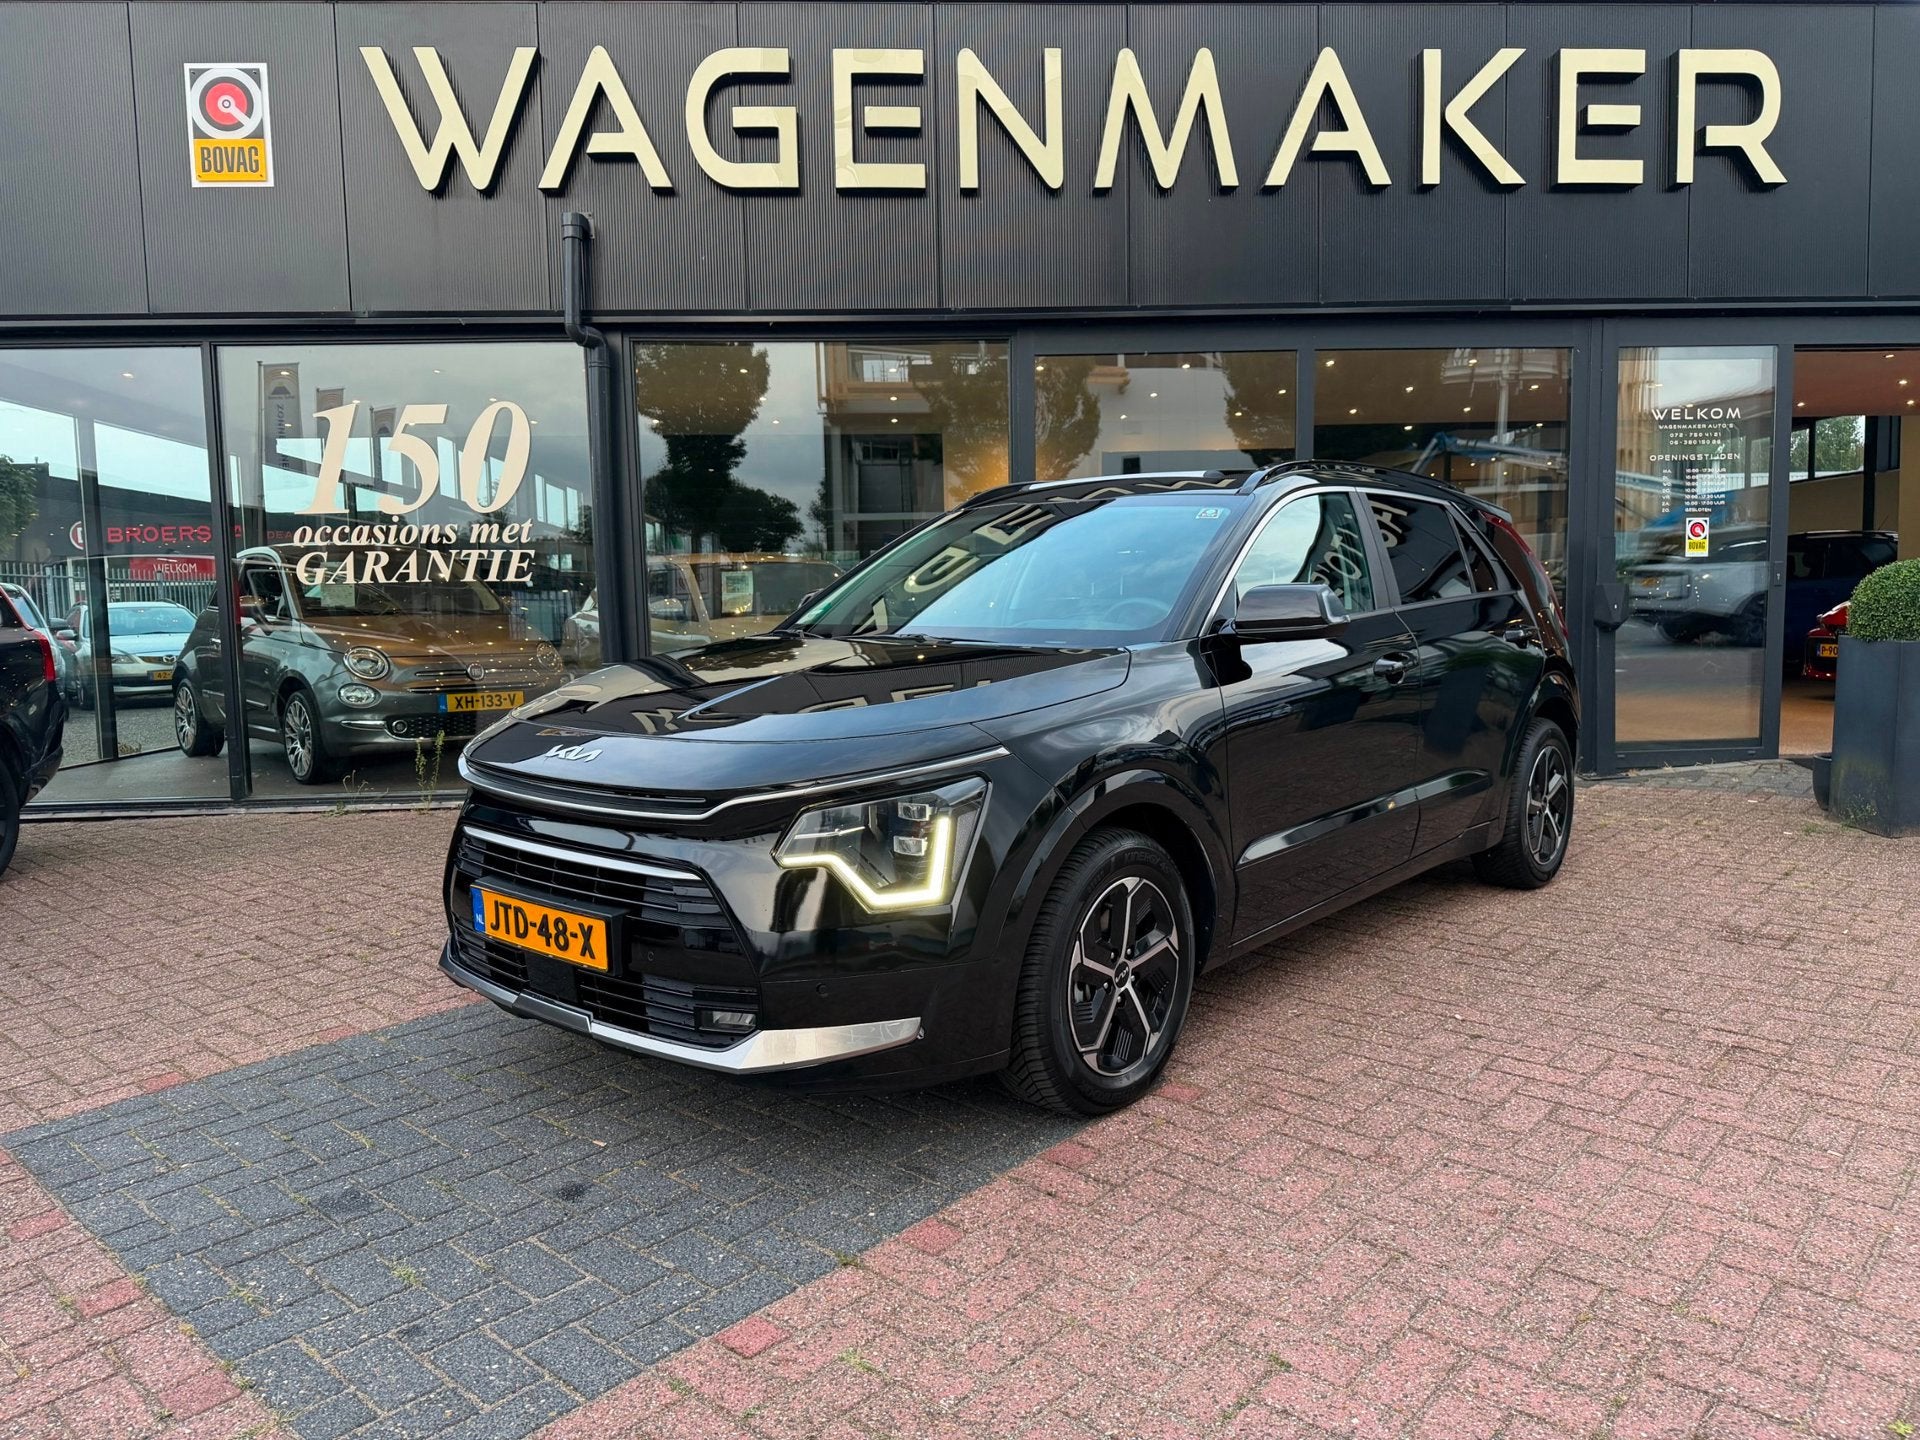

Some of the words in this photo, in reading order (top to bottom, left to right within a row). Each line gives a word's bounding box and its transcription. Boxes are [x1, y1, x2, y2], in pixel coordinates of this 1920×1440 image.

[358, 45, 1788, 190] WAGENMAKER
[200, 145, 260, 174] BOVAG
[1651, 407, 1741, 420] WELKOM
[293, 401, 531, 515] 150
[1649, 453, 1740, 462] OPENINGSTIJDEN
[293, 515, 458, 547] occasions
[470, 518, 534, 544] met
[1689, 542, 1706, 550] BOVAG
[152, 563, 198, 573] WELKOM
[296, 549, 536, 586] GARANTIE
[454, 694, 516, 710] XH-133-V
[476, 913, 484, 925] NL
[490, 900, 596, 960] JTD-48-X
